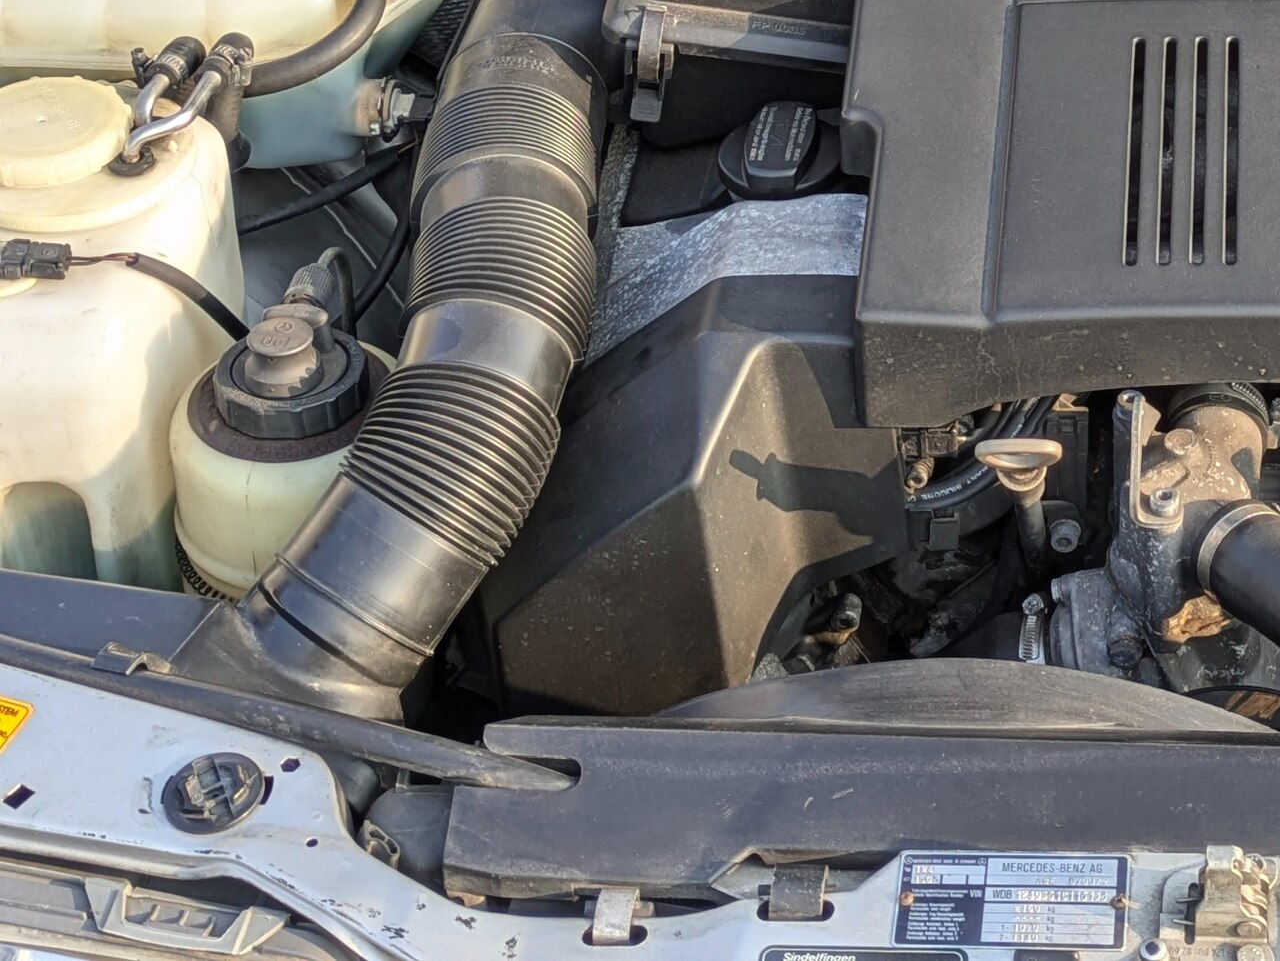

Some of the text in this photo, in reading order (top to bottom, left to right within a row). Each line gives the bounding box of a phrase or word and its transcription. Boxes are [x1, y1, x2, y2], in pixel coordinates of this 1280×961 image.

[1002, 862, 1103, 874] MERCEDES-BENZ AG
[969, 889, 983, 898] VIN
[992, 889, 1012, 899] WDB
[1048, 906, 1055, 914] kg
[1047, 915, 1055, 923] kg
[1046, 925, 1054, 933] kg
